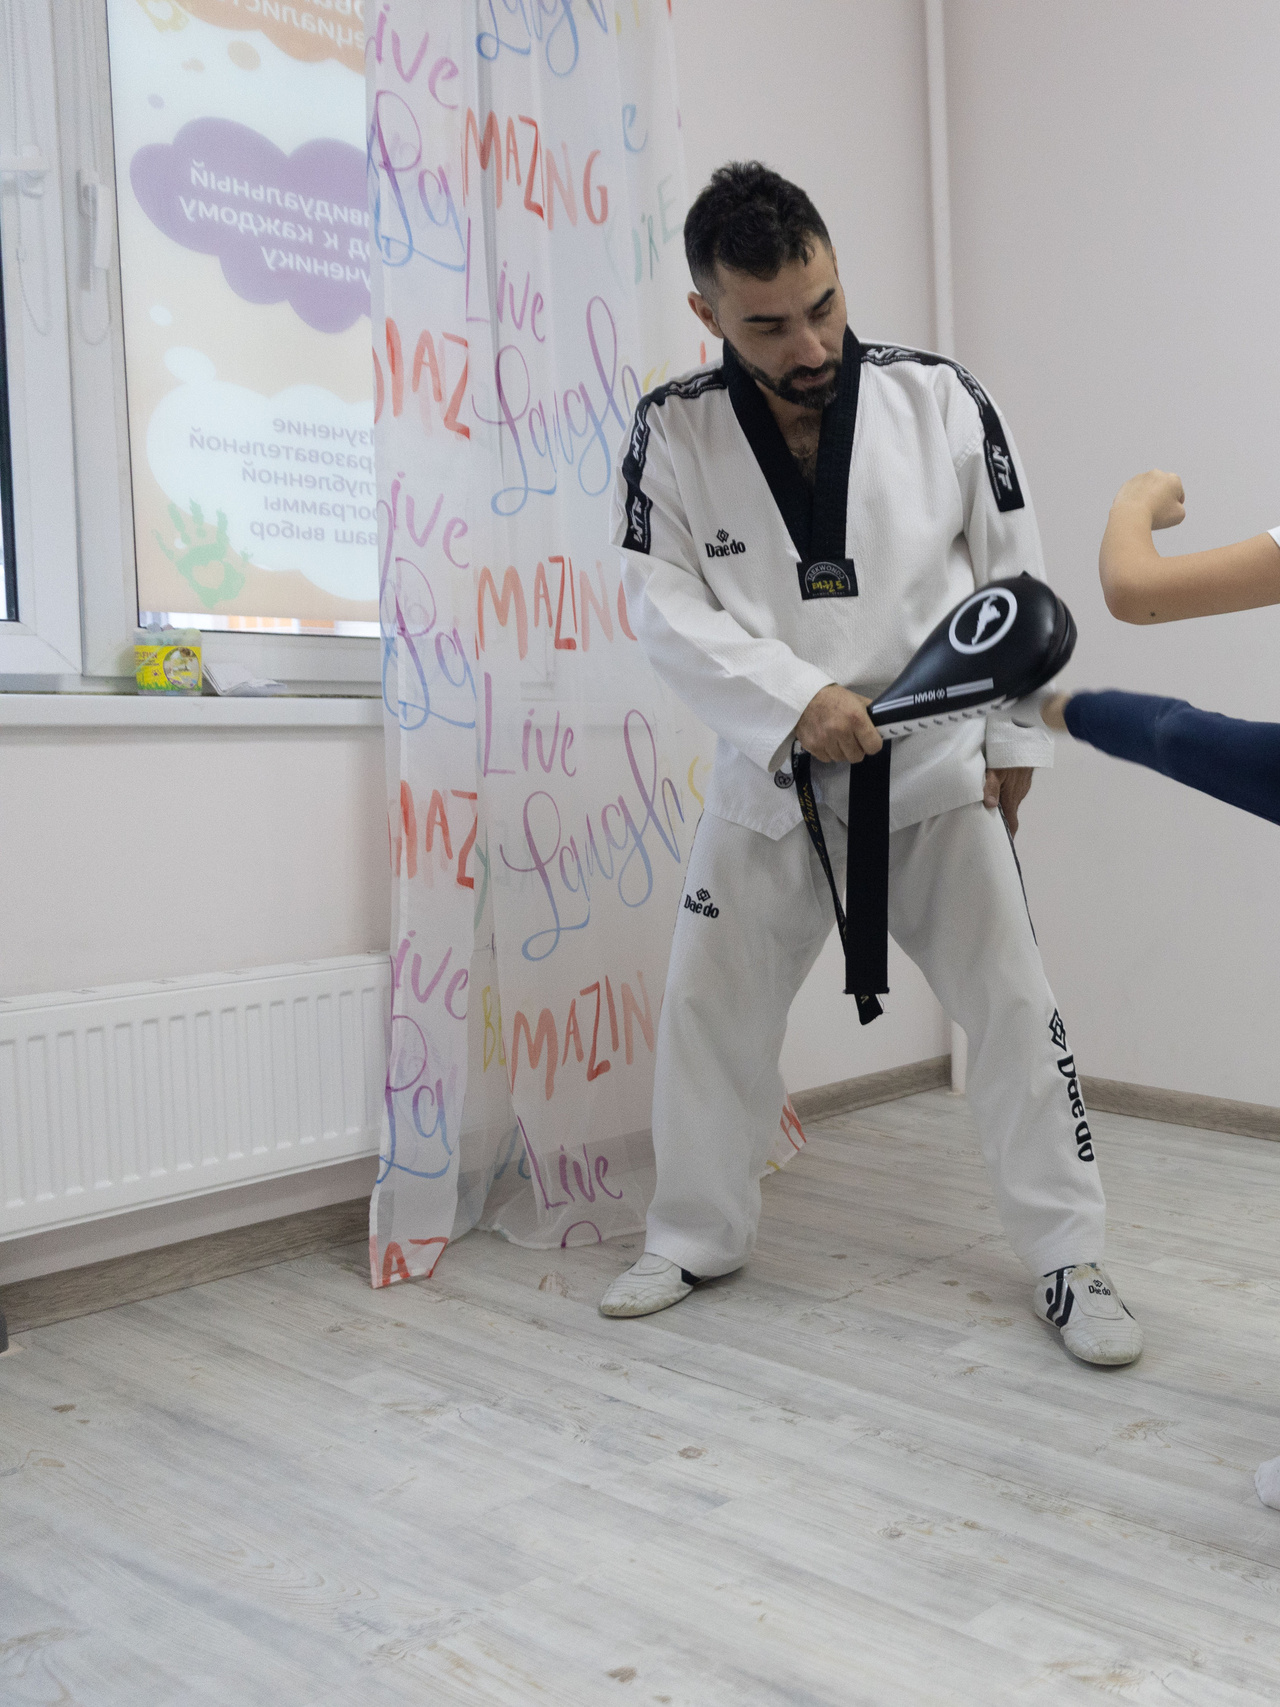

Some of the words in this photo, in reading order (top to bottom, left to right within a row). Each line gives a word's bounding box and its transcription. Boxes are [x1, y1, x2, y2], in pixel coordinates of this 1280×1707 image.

[484, 672, 577, 777] Live
[499, 709, 686, 962] Laugh
[517, 1115, 624, 1211] Live
